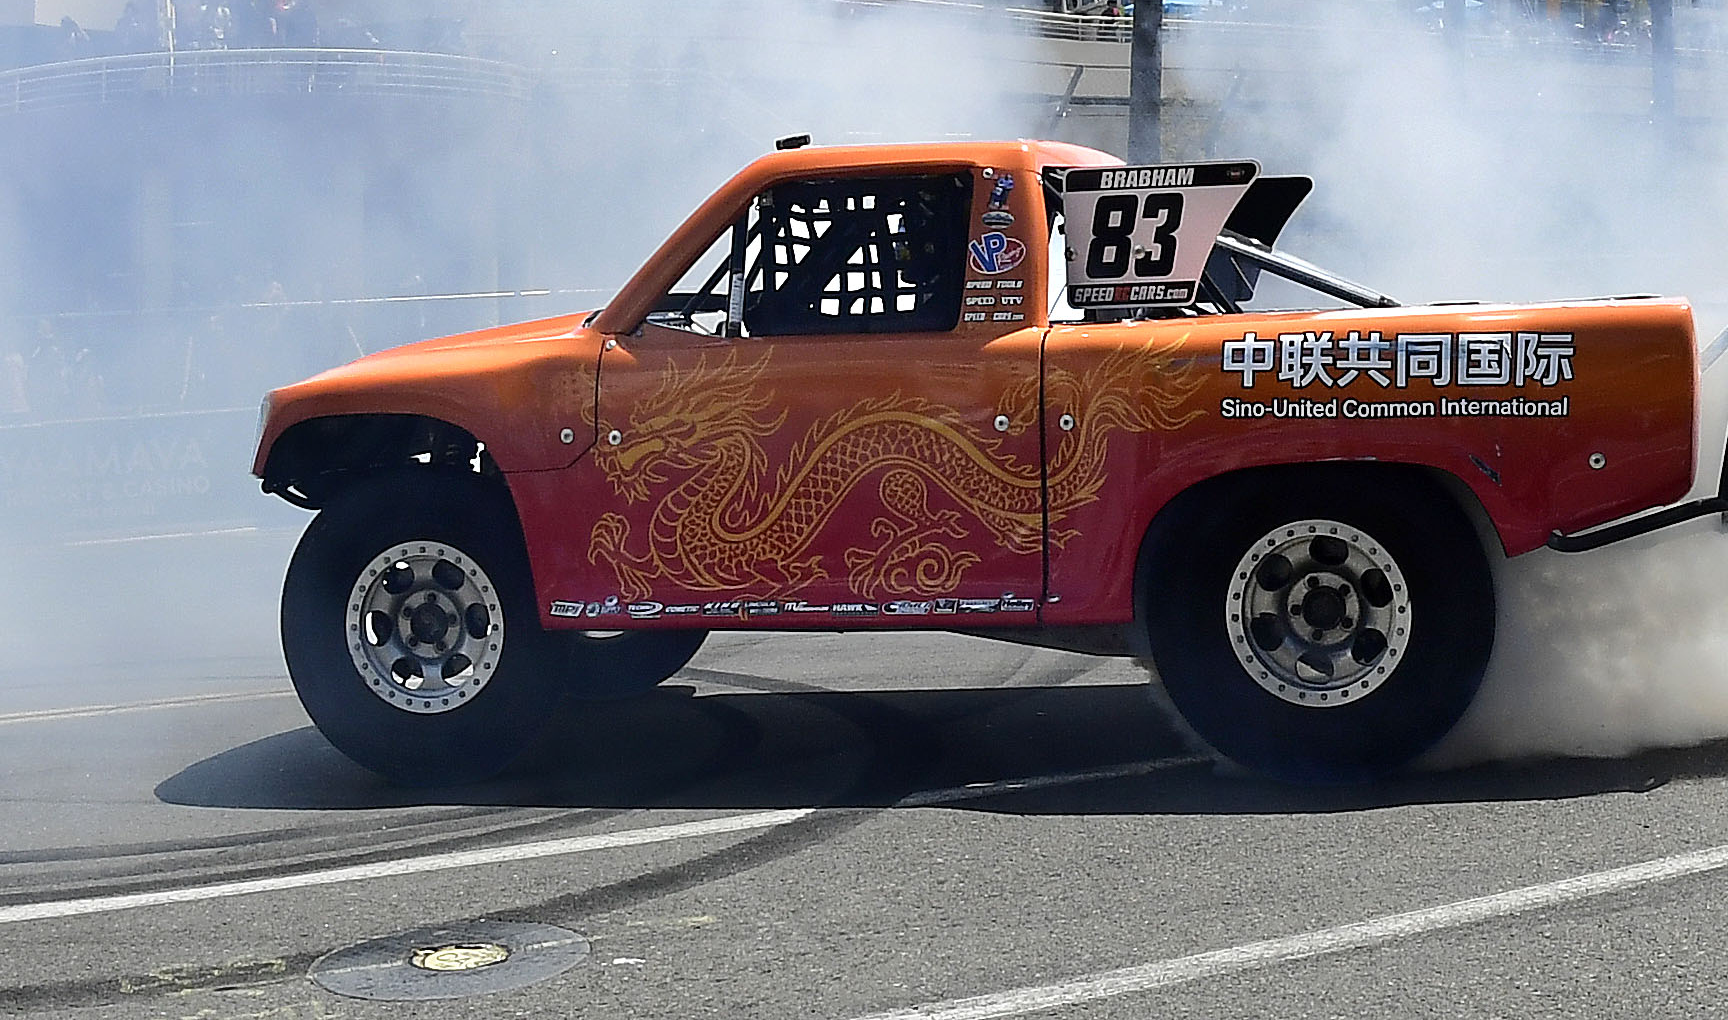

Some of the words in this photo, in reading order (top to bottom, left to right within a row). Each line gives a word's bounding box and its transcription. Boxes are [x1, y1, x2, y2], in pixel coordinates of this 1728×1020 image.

[1100, 168, 1194, 189] BRABHAM
[1086, 192, 1184, 279] 83
[968, 231, 1007, 273] VP
[965, 296, 995, 306] SPEED
[1001, 296, 1023, 305] UTV
[1222, 332, 1575, 388] 中联共同国际
[1221, 399, 1338, 418] Sino-United
[1342, 399, 1435, 418] Common
[1441, 397, 1569, 417] International
[124, 474, 211, 499] CASINO
